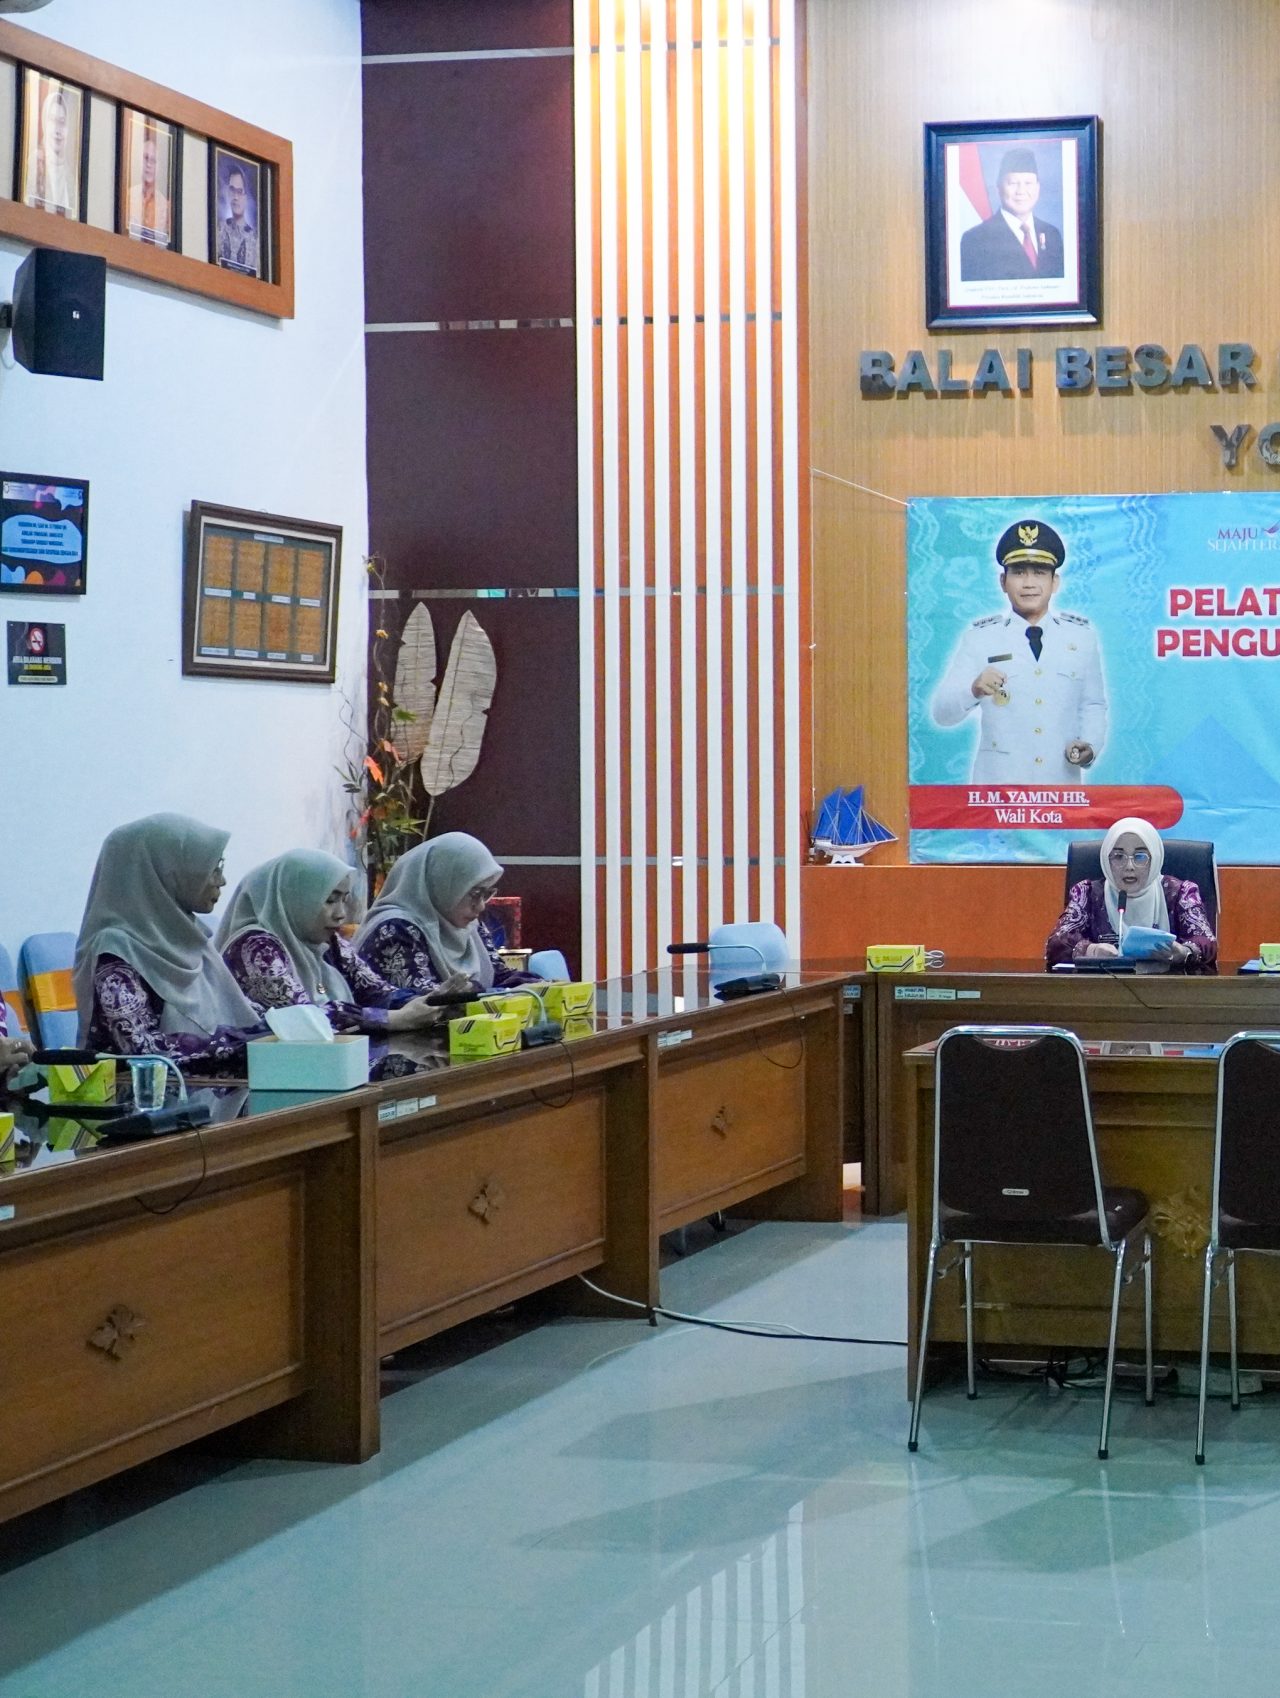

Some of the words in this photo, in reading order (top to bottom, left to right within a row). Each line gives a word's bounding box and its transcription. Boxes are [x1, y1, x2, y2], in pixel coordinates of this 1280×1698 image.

[860, 348, 1033, 399] BALAI
[1055, 343, 1258, 395] BESAR
[1217, 527, 1258, 542] MAJU
[968, 791, 984, 803] H.
[988, 791, 1004, 803] M.
[1008, 791, 1059, 803] YAMIN
[1063, 791, 1090, 804] HR.
[995, 809, 1025, 823] Wali
[1029, 809, 1062, 823] Kota
